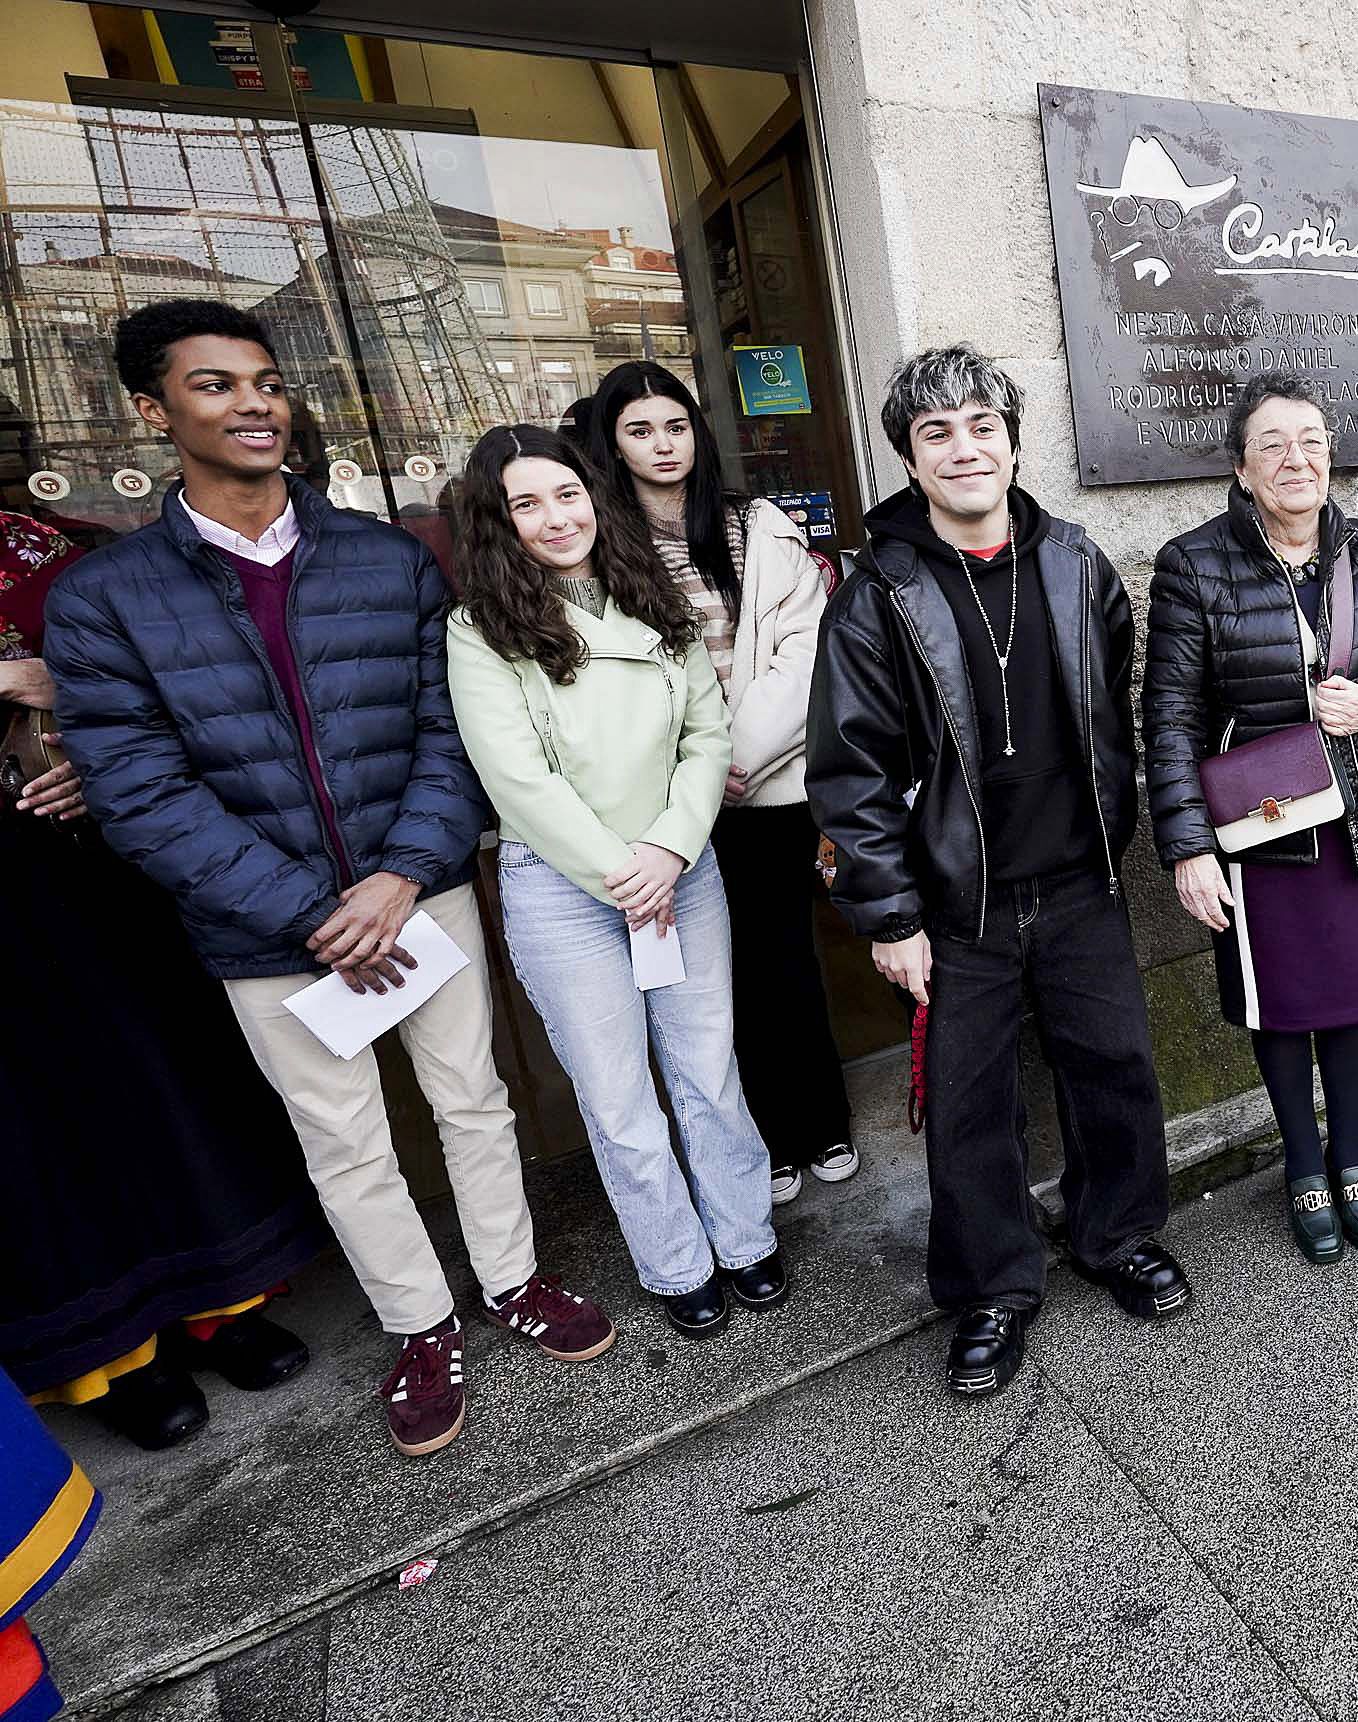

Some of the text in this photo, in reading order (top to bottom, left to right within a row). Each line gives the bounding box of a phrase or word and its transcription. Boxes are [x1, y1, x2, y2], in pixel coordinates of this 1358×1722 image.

[1115, 312, 1197, 336] NESTA
[1203, 313, 1266, 336] CASA
[751, 350, 784, 360] VELO
[1142, 347, 1339, 372] ALFONSO DANIEL
[1137, 418, 1229, 445] E VIRXI
[812, 524, 831, 535] VISA
